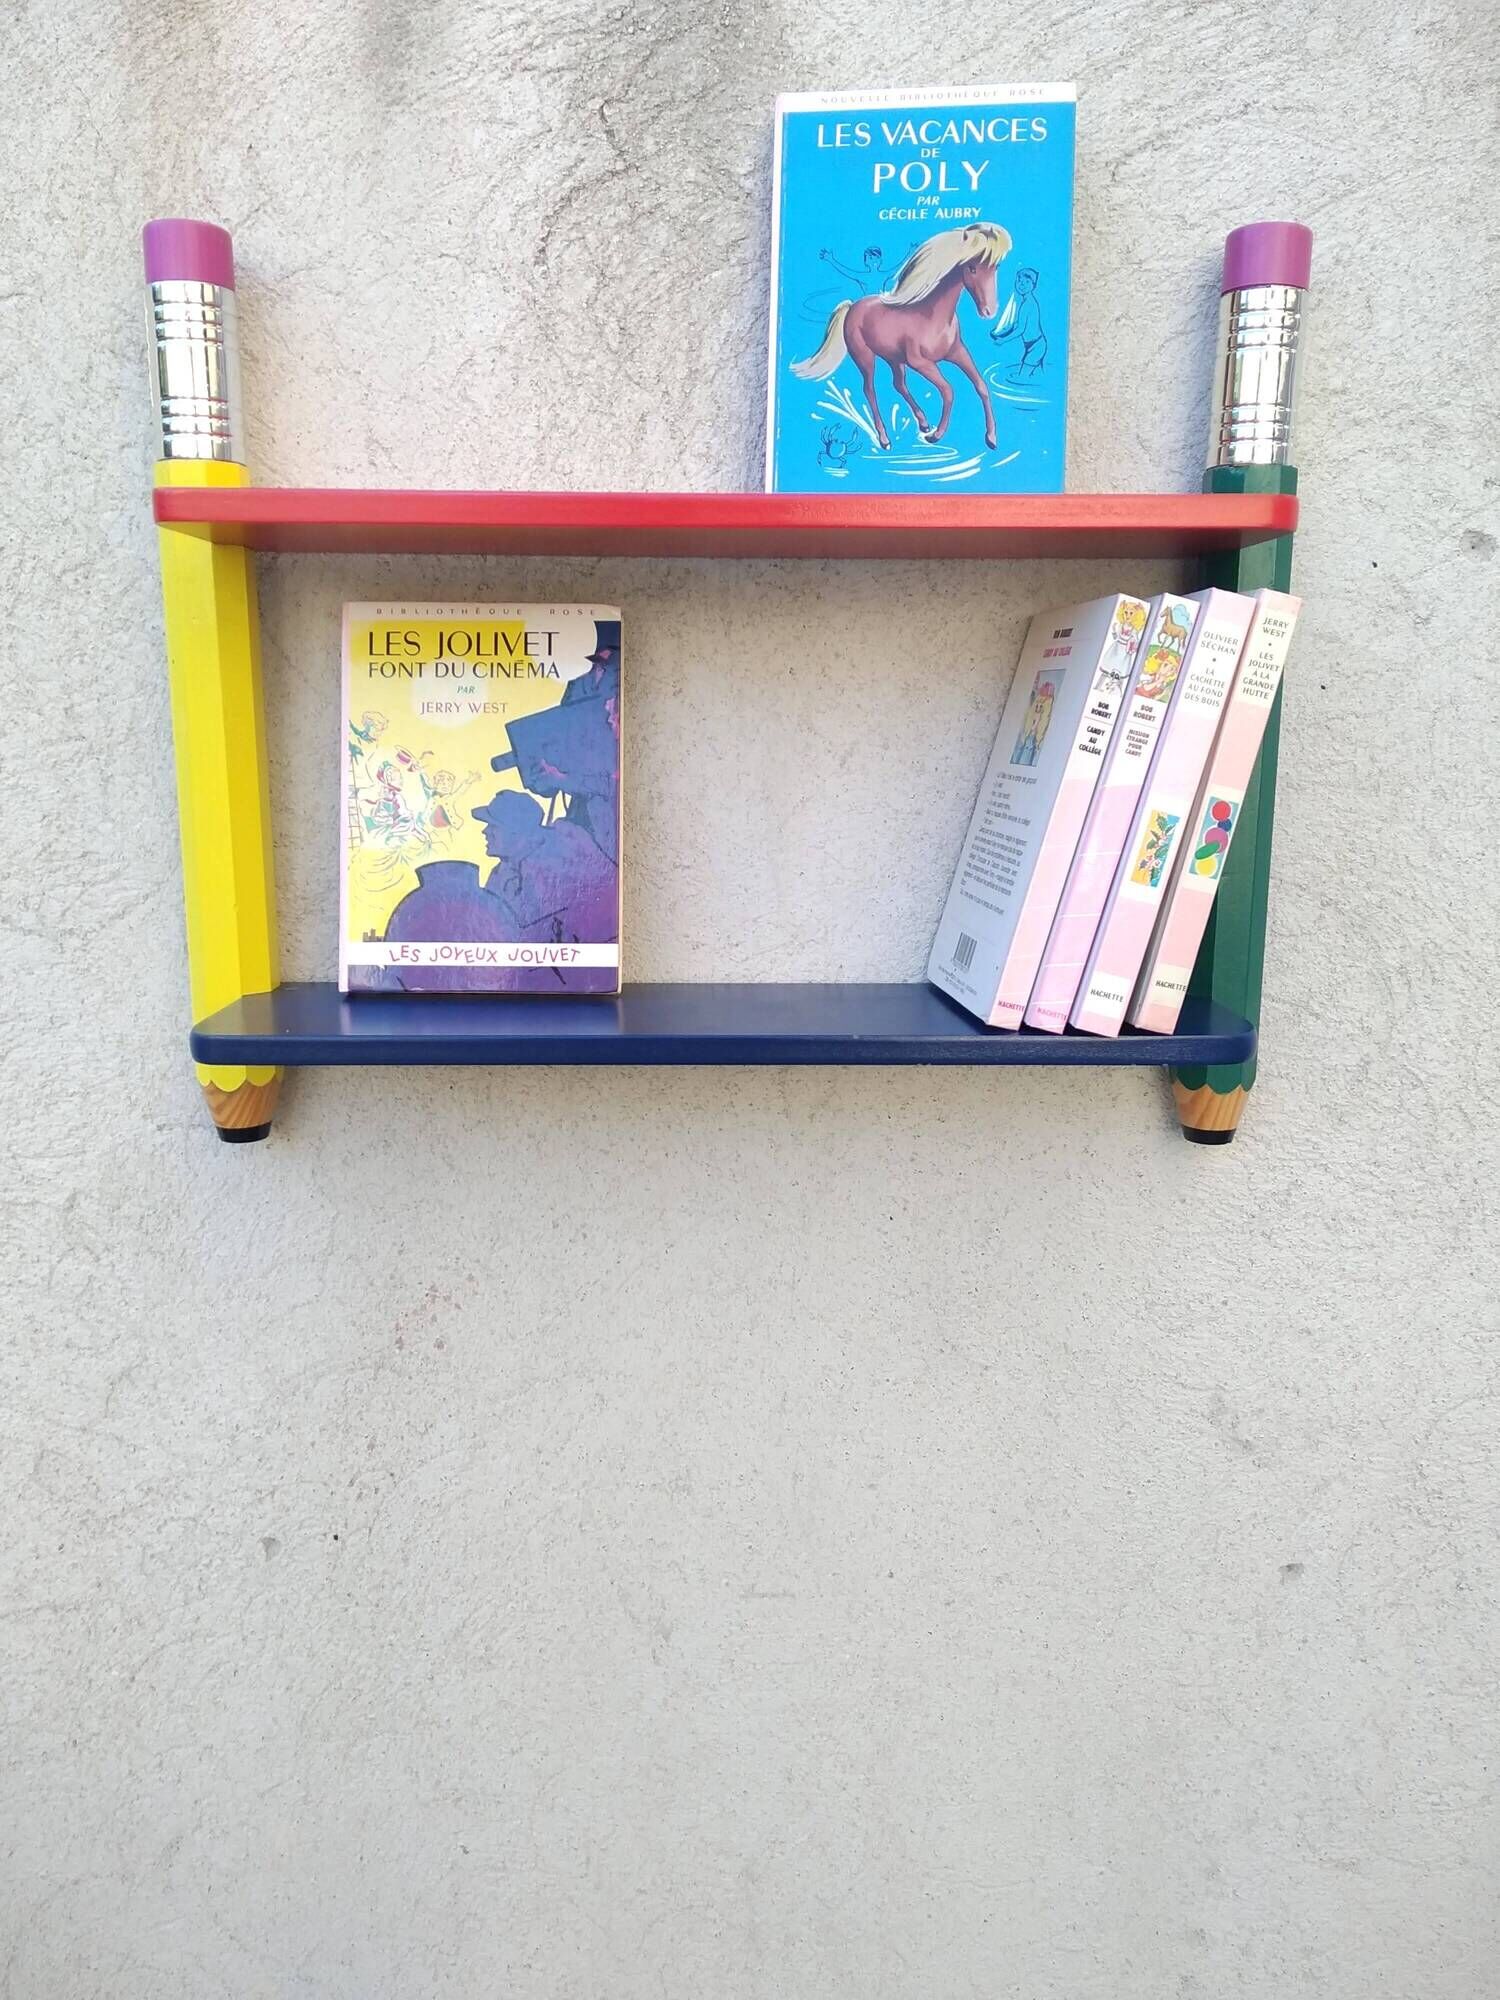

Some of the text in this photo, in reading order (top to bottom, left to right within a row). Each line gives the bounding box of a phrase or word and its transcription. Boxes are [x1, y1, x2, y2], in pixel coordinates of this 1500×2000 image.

[1008, 87, 1046, 97] ROSE
[816, 117, 1048, 148] LES VACANCES
[920, 147, 941, 159] DE
[873, 159, 990, 193] POLY
[916, 195, 940, 206] PAR
[878, 207, 982, 220] CÉCILE AUBRY
[549, 608, 596, 616] ROSE
[1263, 617, 1289, 629] JERRY
[1203, 631, 1239, 646] OLIVIER
[1262, 626, 1286, 639] WEST
[368, 630, 560, 660] LES JOLIVET
[1259, 651, 1275, 661] LES
[368, 659, 561, 679] FONT DU CINÉMA
[1205, 667, 1215, 676] LA
[1248, 658, 1281, 672] JOLIVET
[1190, 674, 1225, 689] CACHETTE
[1260, 670, 1270, 680] LA
[456, 685, 476, 694] PAR
[1188, 683, 1223, 698] AU FOND
[1242, 677, 1275, 691] GRANDE
[1184, 692, 1221, 707] DES BOIS
[1242, 687, 1270, 700] HUTTE
[419, 702, 509, 716] JERRY WEST
[1090, 708, 1112, 719] ROBERT
[1133, 711, 1156, 721] ROBERT
[1086, 725, 1106, 736] CANDY
[1088, 736, 1098, 744] AU
[389, 945, 581, 964] LES JOYEUX JOLIVET
[1155, 980, 1187, 992] HACHETTE
[1090, 988, 1124, 1003] HACHETTE
[1037, 1007, 1068, 1021] HACHETTE
